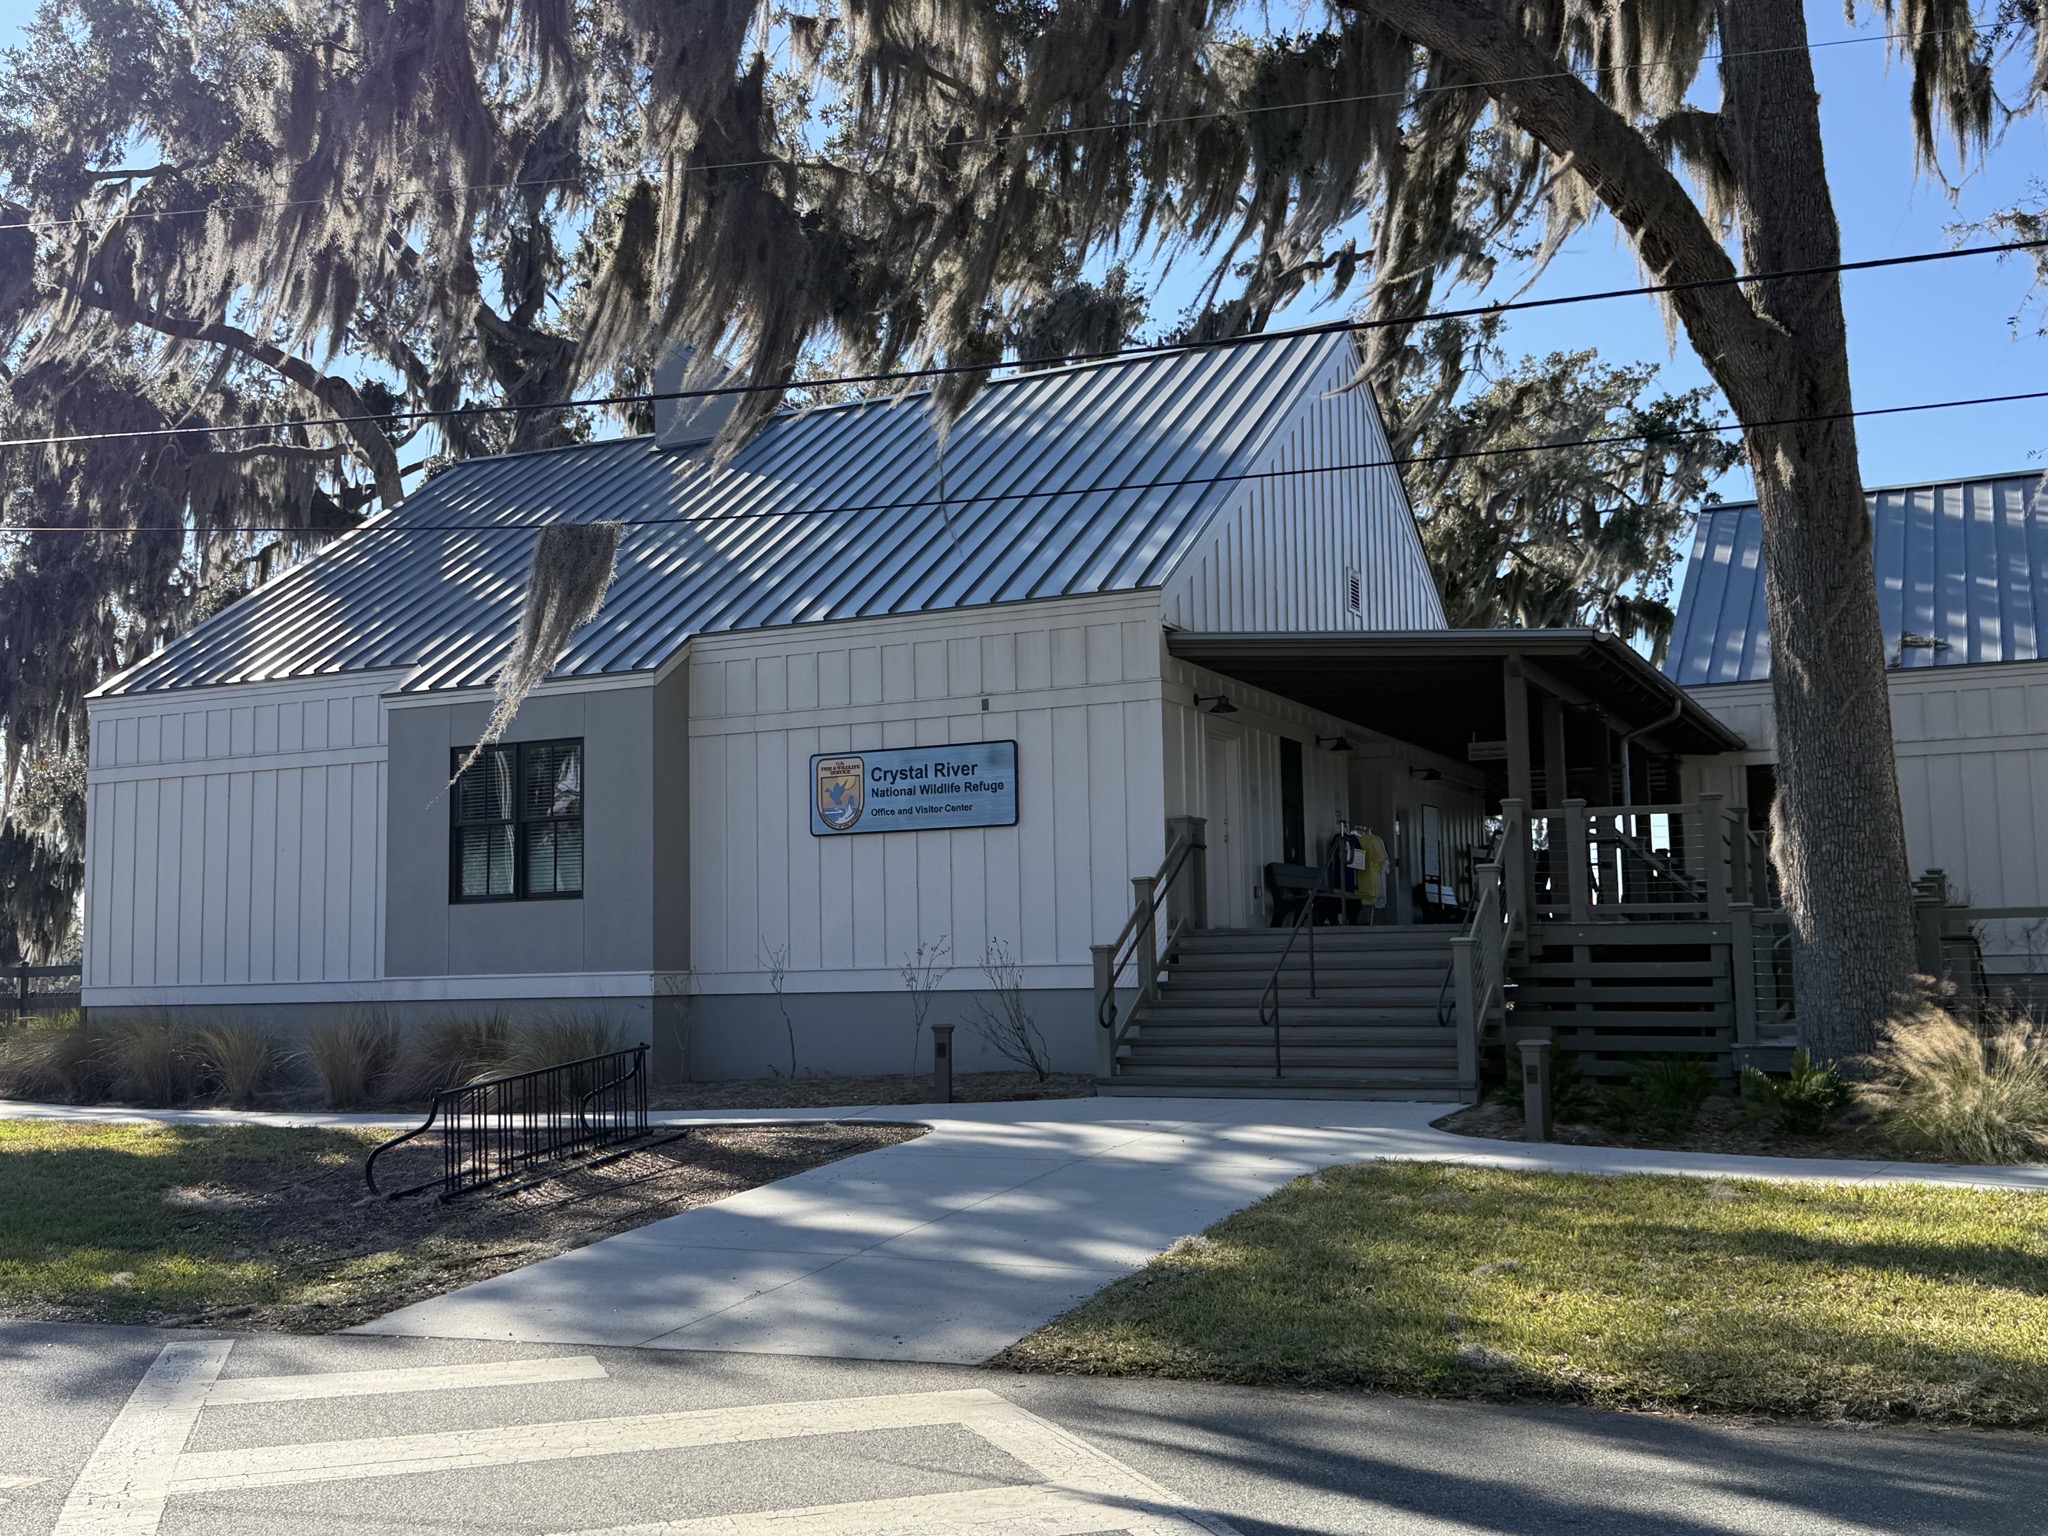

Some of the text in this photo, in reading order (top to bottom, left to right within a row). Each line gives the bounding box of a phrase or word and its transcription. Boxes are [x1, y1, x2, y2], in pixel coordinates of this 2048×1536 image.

[871, 762, 978, 784] Crystal River
[871, 780, 1004, 798] National Wildlife Refuge
[871, 804, 973, 816] Office and Visitor Center
